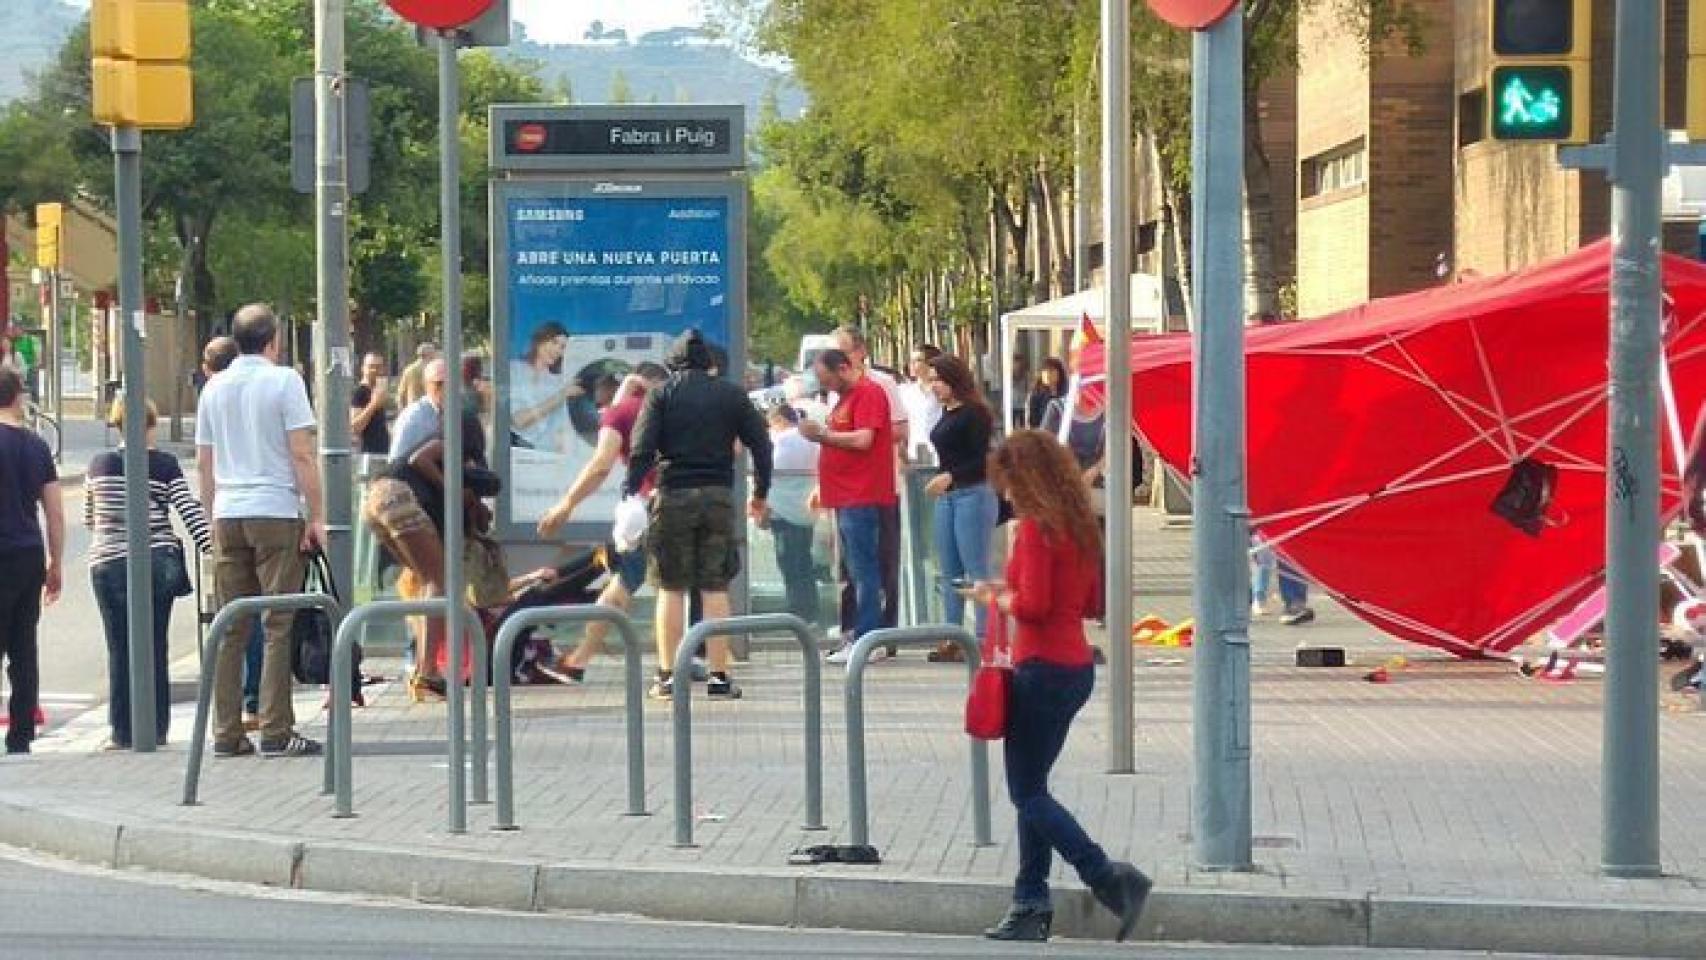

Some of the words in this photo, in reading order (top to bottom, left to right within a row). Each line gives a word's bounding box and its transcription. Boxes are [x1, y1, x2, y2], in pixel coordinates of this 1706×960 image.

[609, 127, 660, 145] Fabra
[675, 126, 716, 148] Puig
[516, 209, 585, 221] SAMSUNG
[517, 251, 559, 265] ABRE
[563, 251, 598, 265] UNA
[602, 251, 655, 265] NUEVA
[660, 251, 721, 265] PUERTA
